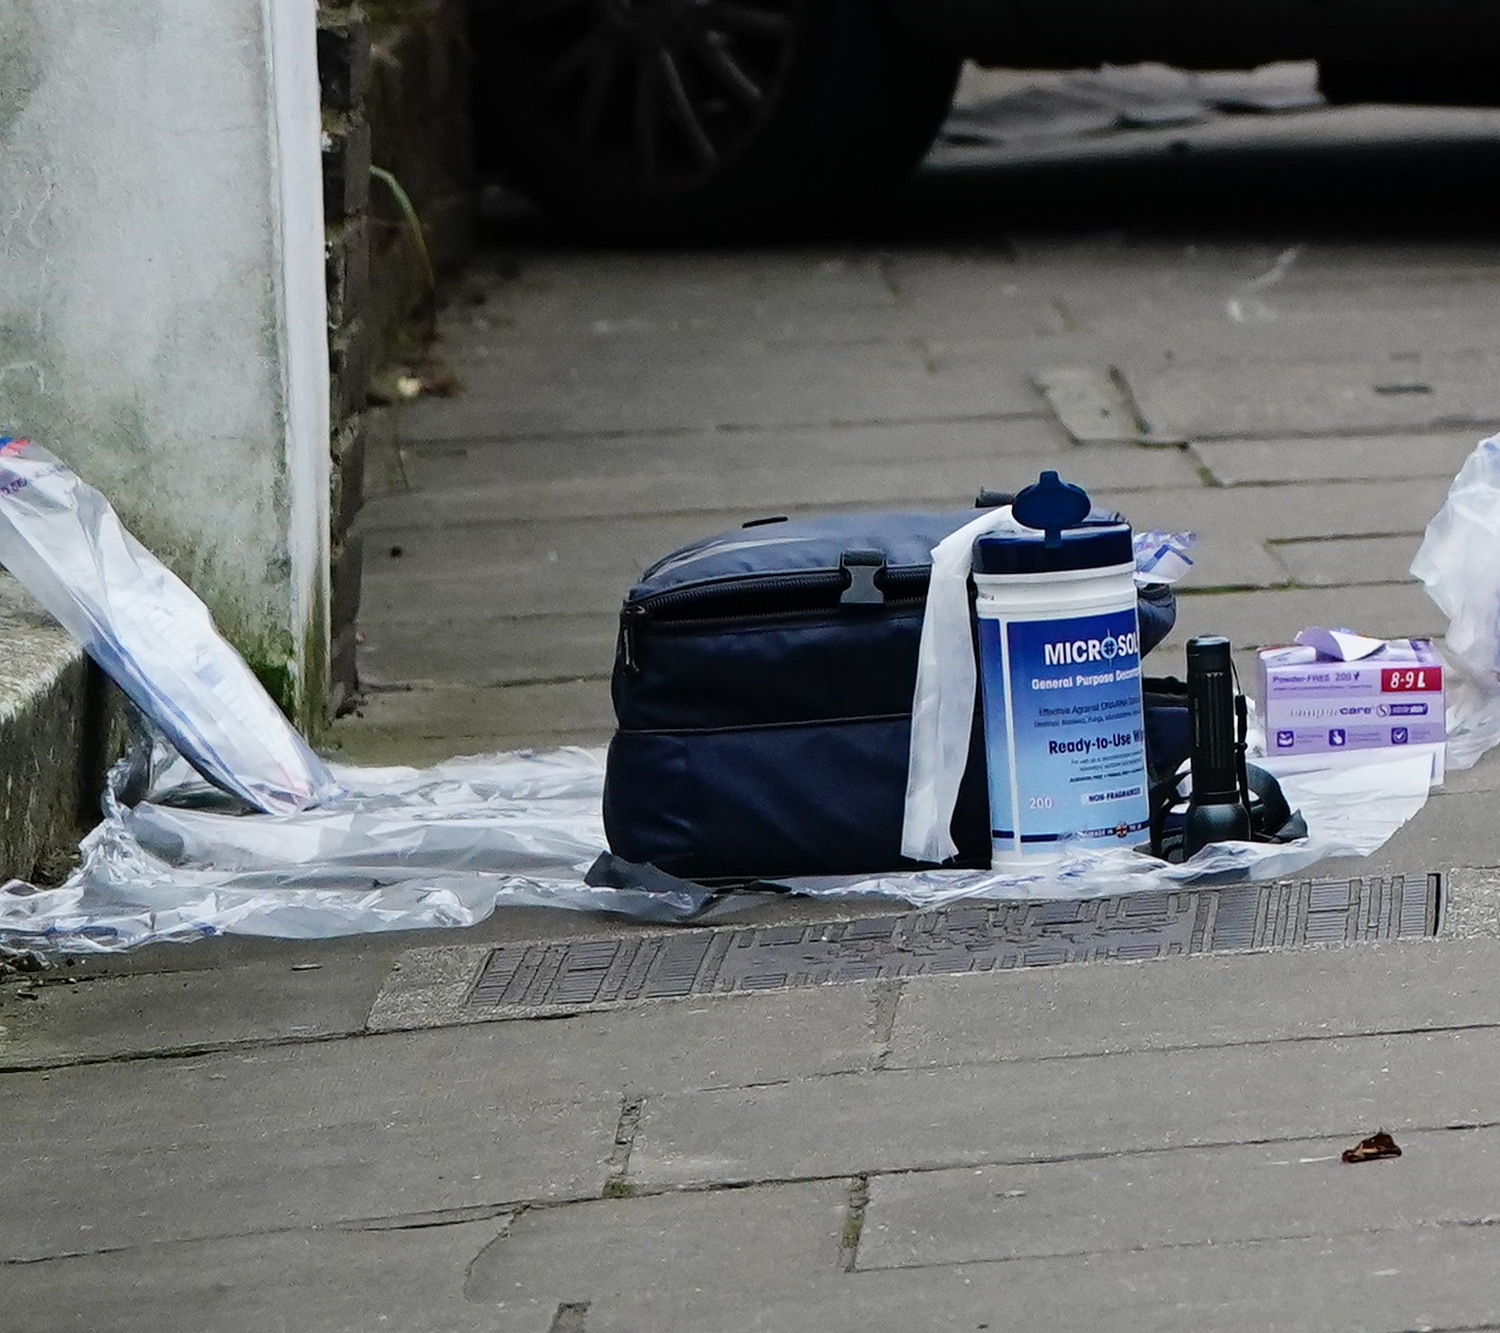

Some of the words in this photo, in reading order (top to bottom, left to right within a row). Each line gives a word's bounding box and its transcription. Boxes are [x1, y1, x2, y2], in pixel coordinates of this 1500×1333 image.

[1031, 677, 1073, 691] General
[1076, 671, 1114, 687] Purpose
[1048, 735, 1131, 754] Ready-to-Use
[1029, 796, 1053, 810] 200
